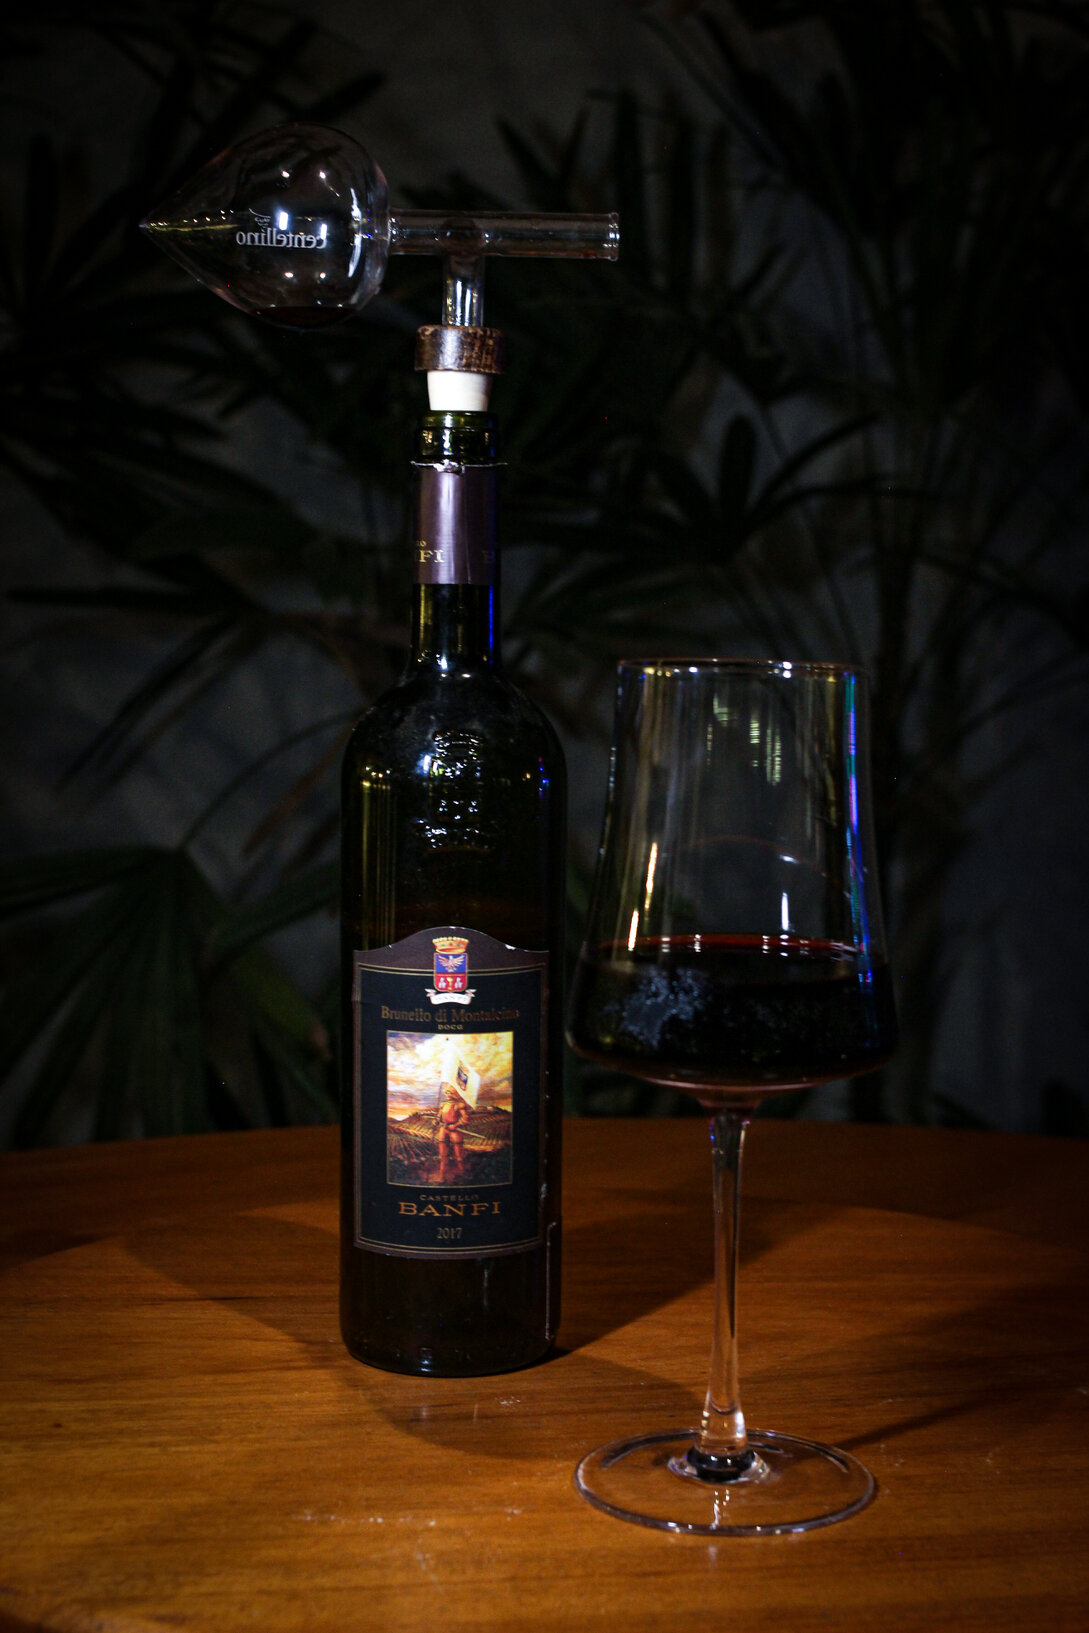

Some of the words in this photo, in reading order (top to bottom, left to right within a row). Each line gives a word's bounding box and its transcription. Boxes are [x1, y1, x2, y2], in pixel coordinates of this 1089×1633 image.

[416, 549, 445, 563] FI
[381, 1005, 431, 1022] Brunello
[434, 1008, 447, 1022] di
[451, 1007, 520, 1022] Montalcino
[419, 1194, 480, 1202] CASTELLO
[399, 1201, 501, 1216] BANFI
[437, 1228, 463, 1239] 2017
